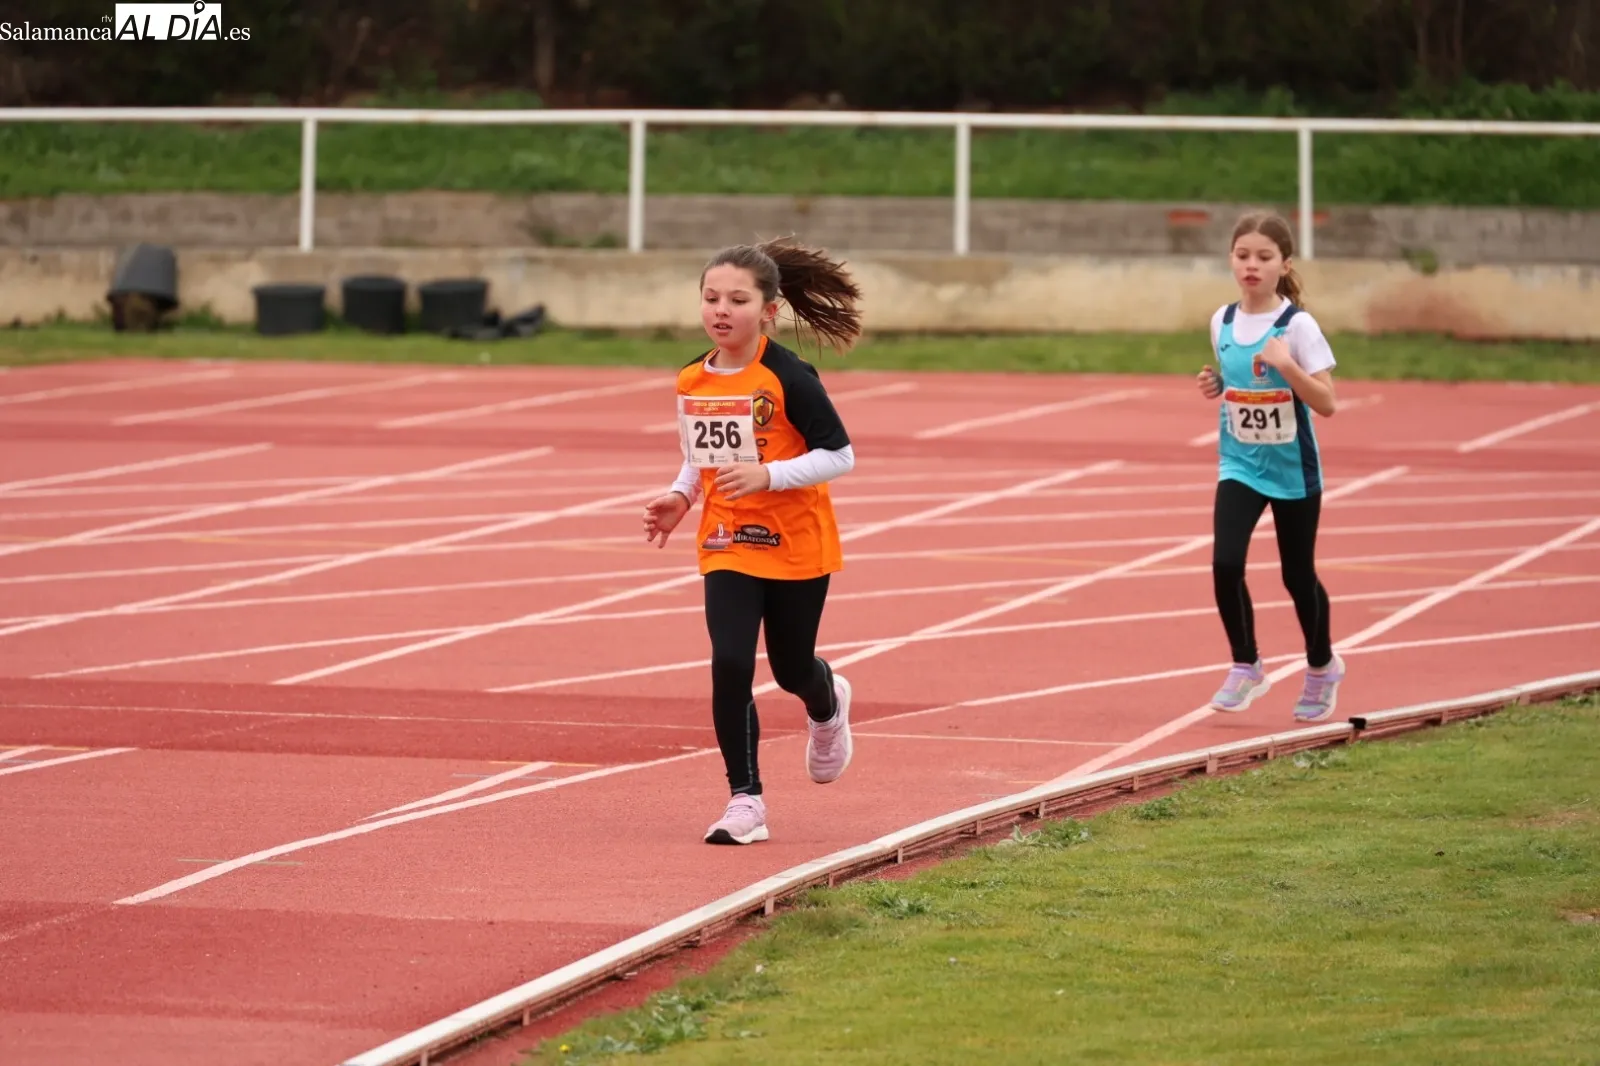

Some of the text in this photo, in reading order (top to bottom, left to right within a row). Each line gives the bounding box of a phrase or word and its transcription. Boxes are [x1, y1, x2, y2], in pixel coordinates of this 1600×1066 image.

[1238, 407, 1282, 430] 291
[694, 421, 742, 449] 256
[733, 533, 778, 545] MIRATONDA
